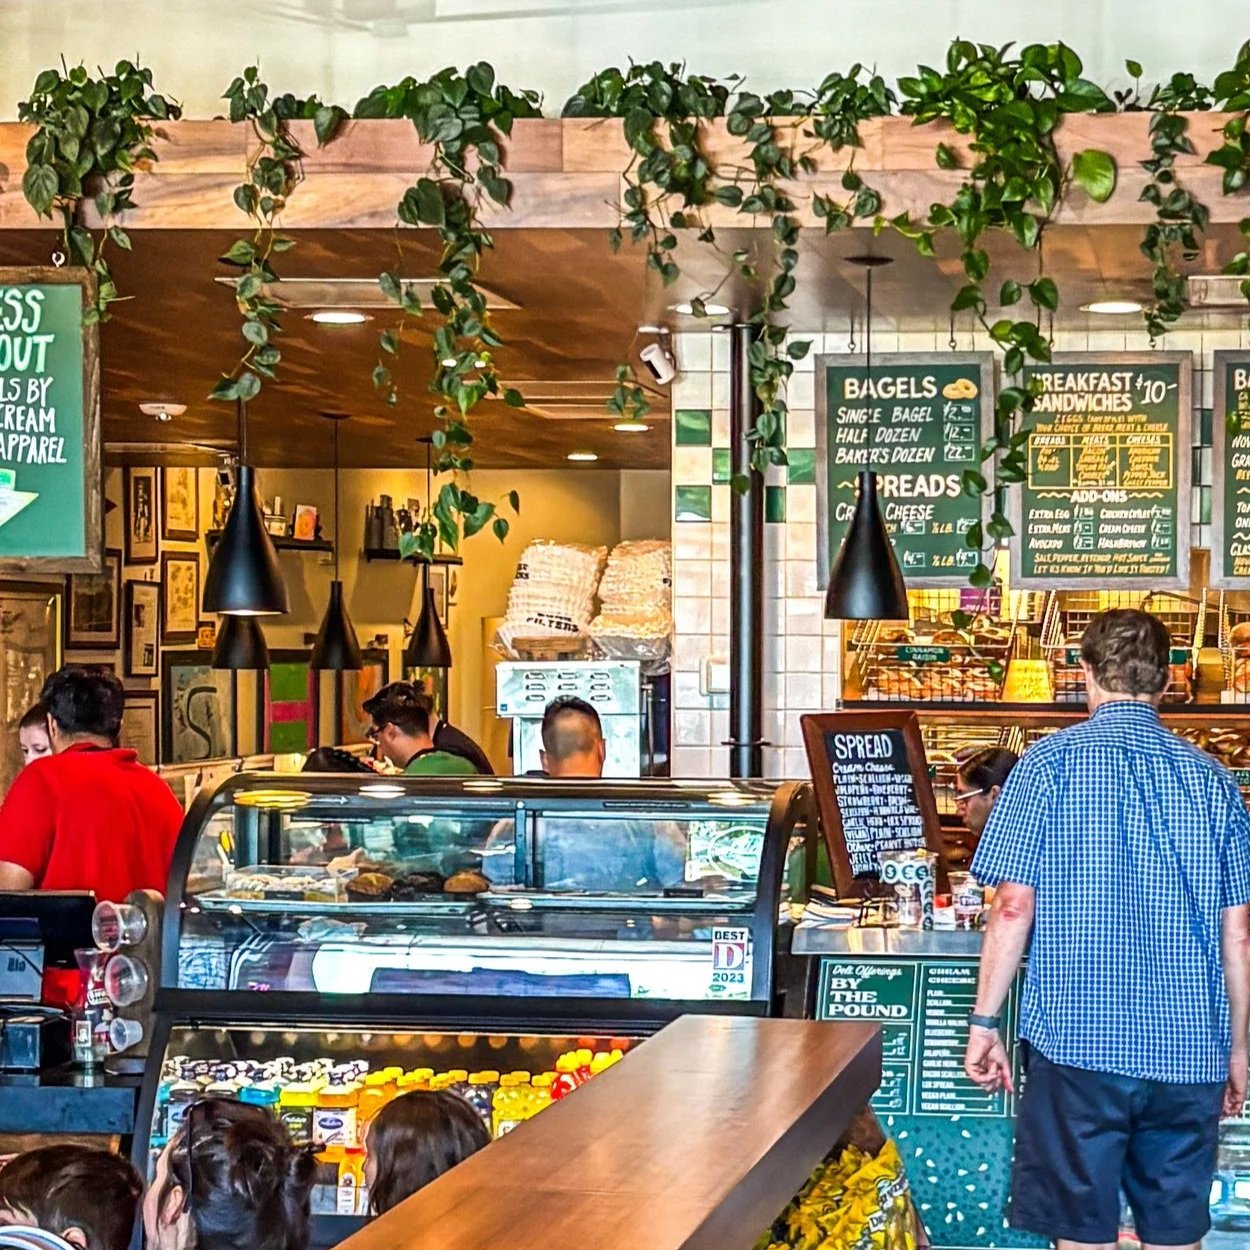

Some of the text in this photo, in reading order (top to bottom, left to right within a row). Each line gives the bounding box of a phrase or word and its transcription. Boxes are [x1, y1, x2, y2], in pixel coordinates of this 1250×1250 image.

[27, 376, 53, 407] BY
[844, 376, 938, 400] BAGELS
[1032, 392, 1133, 412] SANDWICHES
[836, 406, 934, 424] SINGLE BAGEL
[835, 427, 922, 443] HALF DOZEN
[1034, 437, 1066, 446] BREADS
[1081, 435, 1109, 445] MEATS
[1126, 435, 1161, 445] CHEESES
[891, 447, 935, 462] DOZEN
[1070, 490, 1129, 504] ADD-ONS
[885, 502, 935, 521] CHEESE
[1029, 508, 1070, 519] EXTRA EGG
[1028, 522, 1051, 534] EXTRA
[1029, 537, 1064, 549] AVOCADO
[1033, 564, 1049, 574] LET
[834, 733, 893, 759] SPREAD
[832, 761, 897, 774] Cream Cheese
[714, 931, 745, 940] BEST
[717, 943, 744, 969] D
[712, 972, 745, 983] 2023
[832, 964, 903, 981] Deli Offerings
[928, 968, 971, 976] CREAM
[831, 977, 863, 990] BY
[829, 990, 878, 1003] THE
[828, 1004, 908, 1018] POUND
